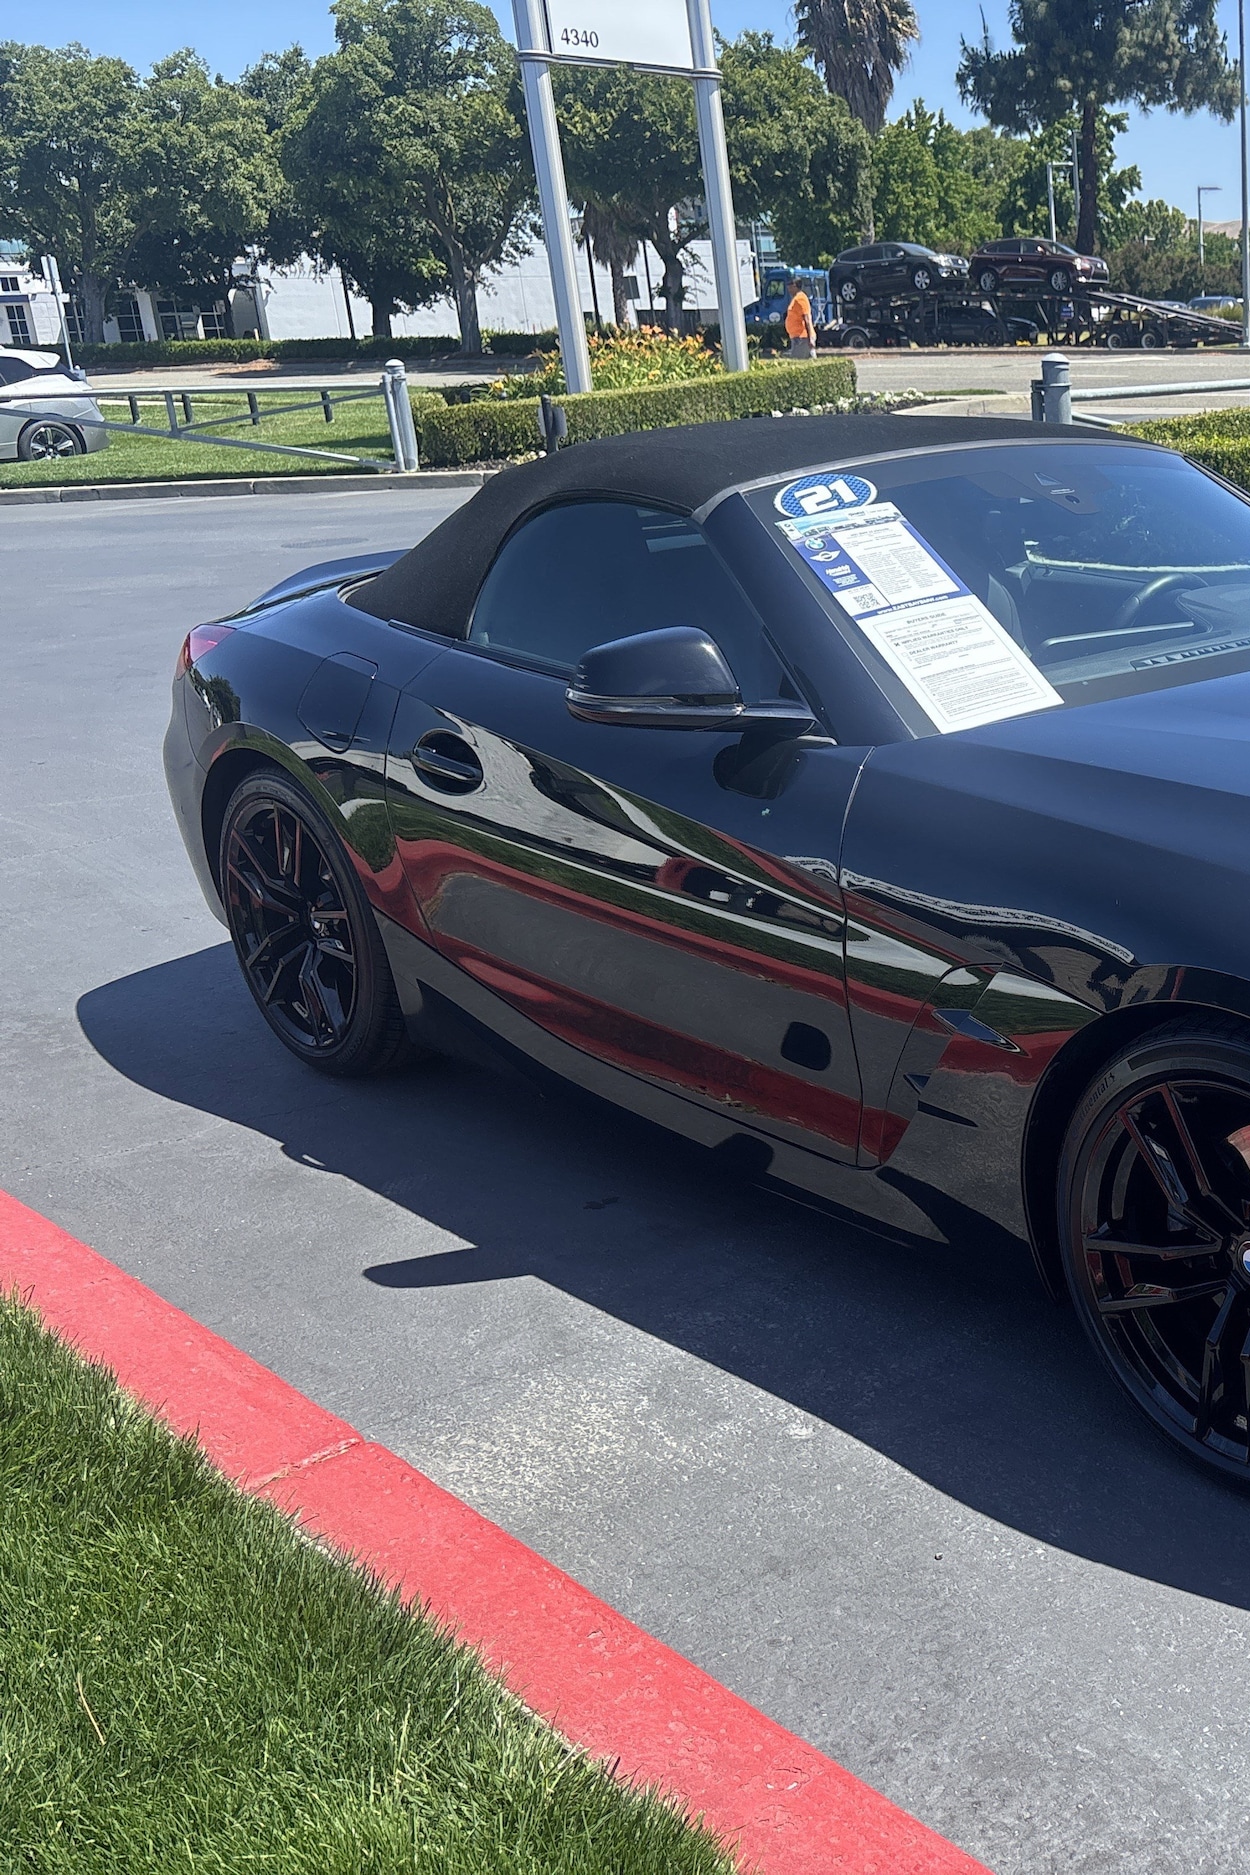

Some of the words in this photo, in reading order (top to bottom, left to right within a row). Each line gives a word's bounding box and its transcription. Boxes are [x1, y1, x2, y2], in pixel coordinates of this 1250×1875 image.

[561, 28, 599, 48] 4340
[793, 478, 859, 515] 21
[906, 615, 929, 625] BUYERS
[930, 612, 947, 620] GUIDE
[901, 637, 922, 645] IMPLIED
[922, 629, 955, 640] WARRANTIES
[908, 646, 930, 656] DEALER
[930, 640, 959, 650] WARRANTY
